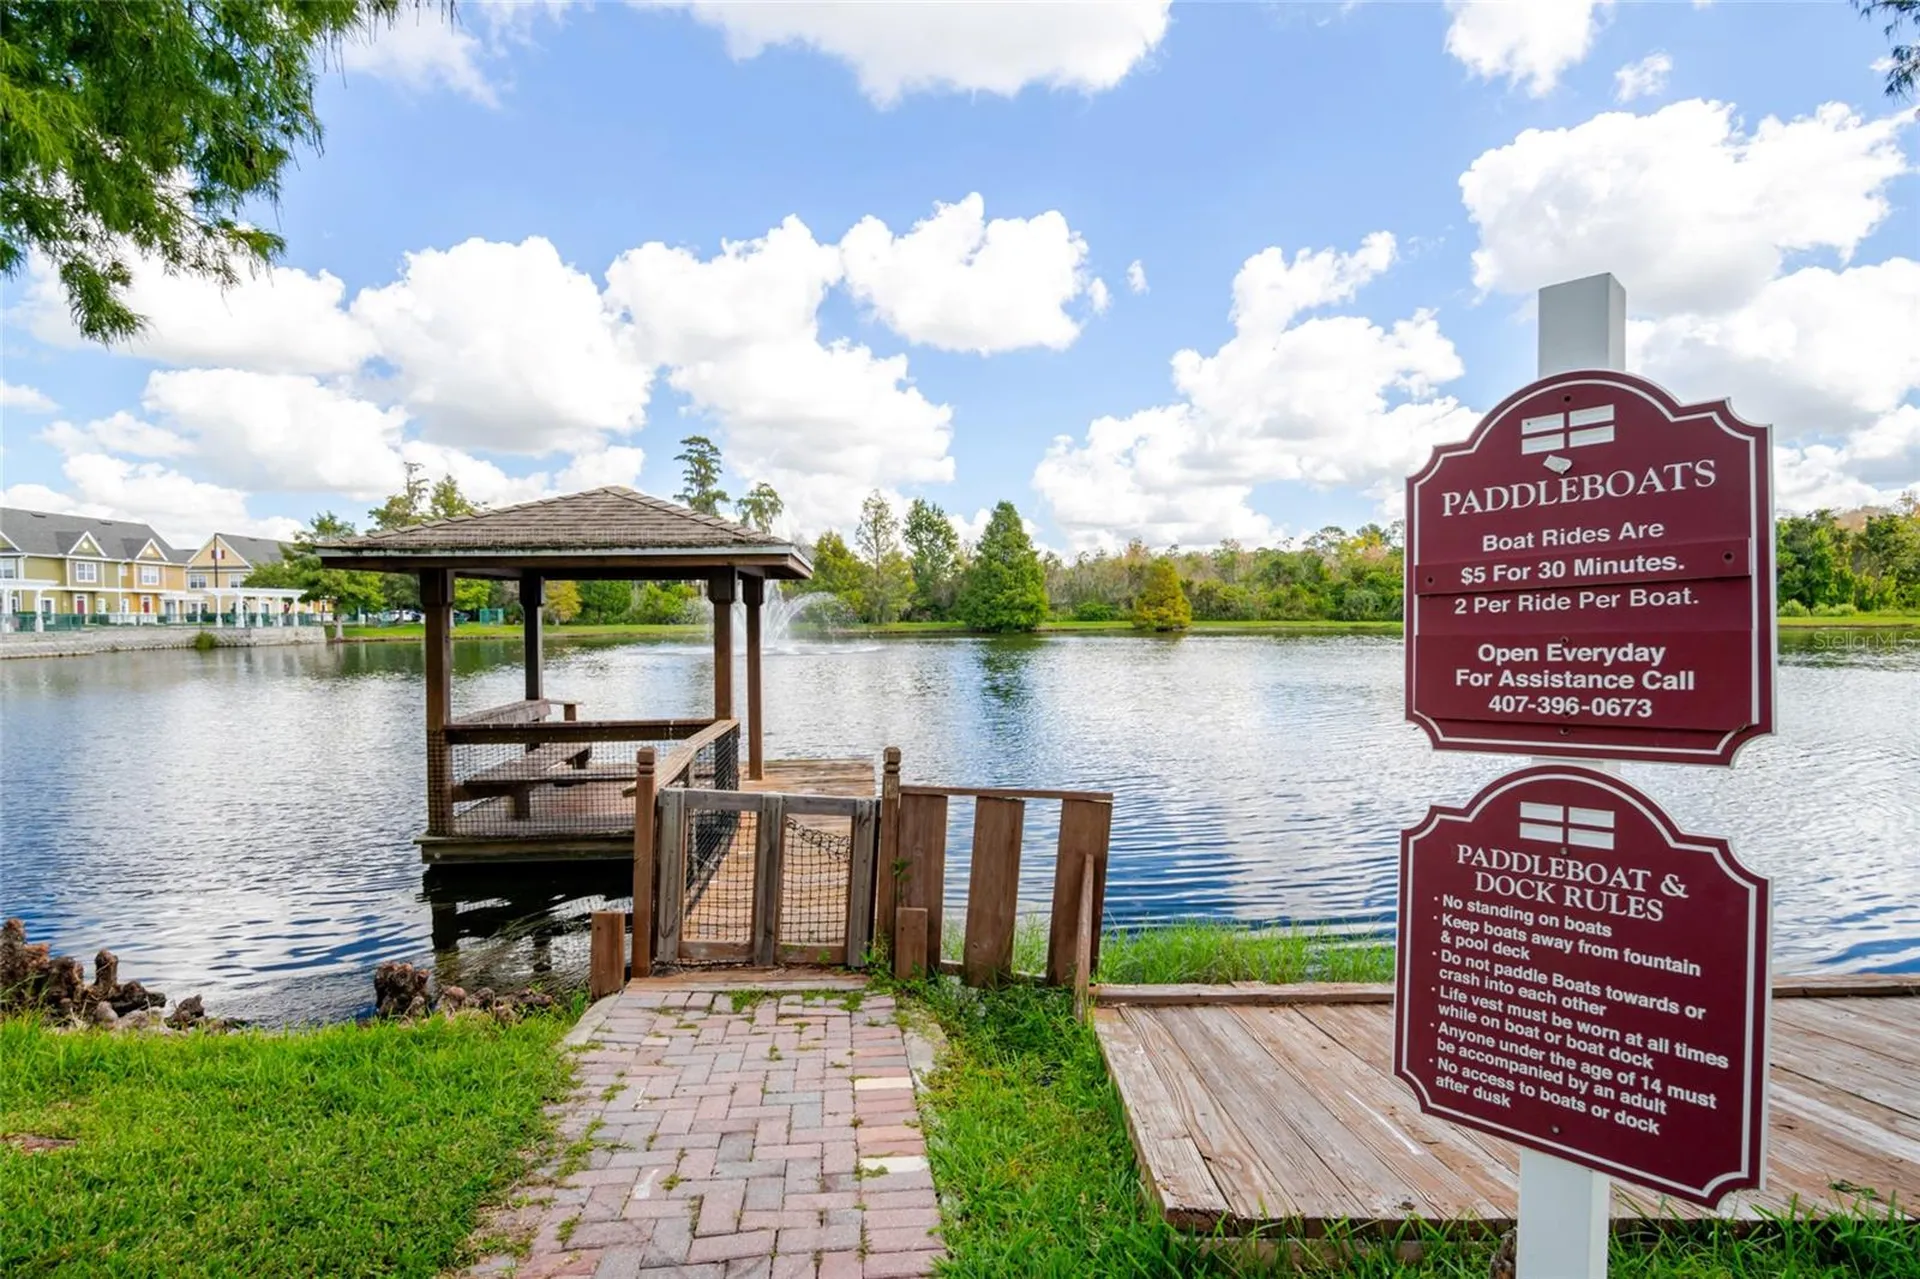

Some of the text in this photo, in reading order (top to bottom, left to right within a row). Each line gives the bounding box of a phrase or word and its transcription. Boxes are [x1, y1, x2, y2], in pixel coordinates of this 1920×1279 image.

[1442, 458, 1716, 516] PADDLEBOATS
[1483, 522, 1664, 552] Boat Rides Are
[1461, 555, 1684, 585] $5 For 30 Minutes.
[1455, 588, 1698, 614] 2 Per Ride Per Boat.
[1478, 643, 1666, 666] Open Everyday
[1456, 669, 1694, 690] For Assistance Call
[1488, 695, 1652, 717] 407-396-0673
[1457, 844, 1688, 898] PADDLEBOAT &
[1443, 894, 1612, 937] No standing on boats
[1476, 872, 1663, 921] DOCK RULES
[1441, 930, 1530, 960] & pool deck
[1443, 913, 1700, 976] Keep boats away from fountain
[1439, 969, 1606, 1016] crash into each other
[1441, 949, 1706, 1019] Do not paddle Boats towards or
[1438, 1004, 1653, 1069] while on boat or boat dock
[1440, 985, 1728, 1068] Life vest must be worn at all times
[1437, 1038, 1666, 1114] be accompanied by an adult
[1438, 1022, 1716, 1109] Anyone under the age of 14 must
[1436, 1076, 1510, 1107] after dusk
[1438, 1057, 1659, 1135] No access to boats or dock
